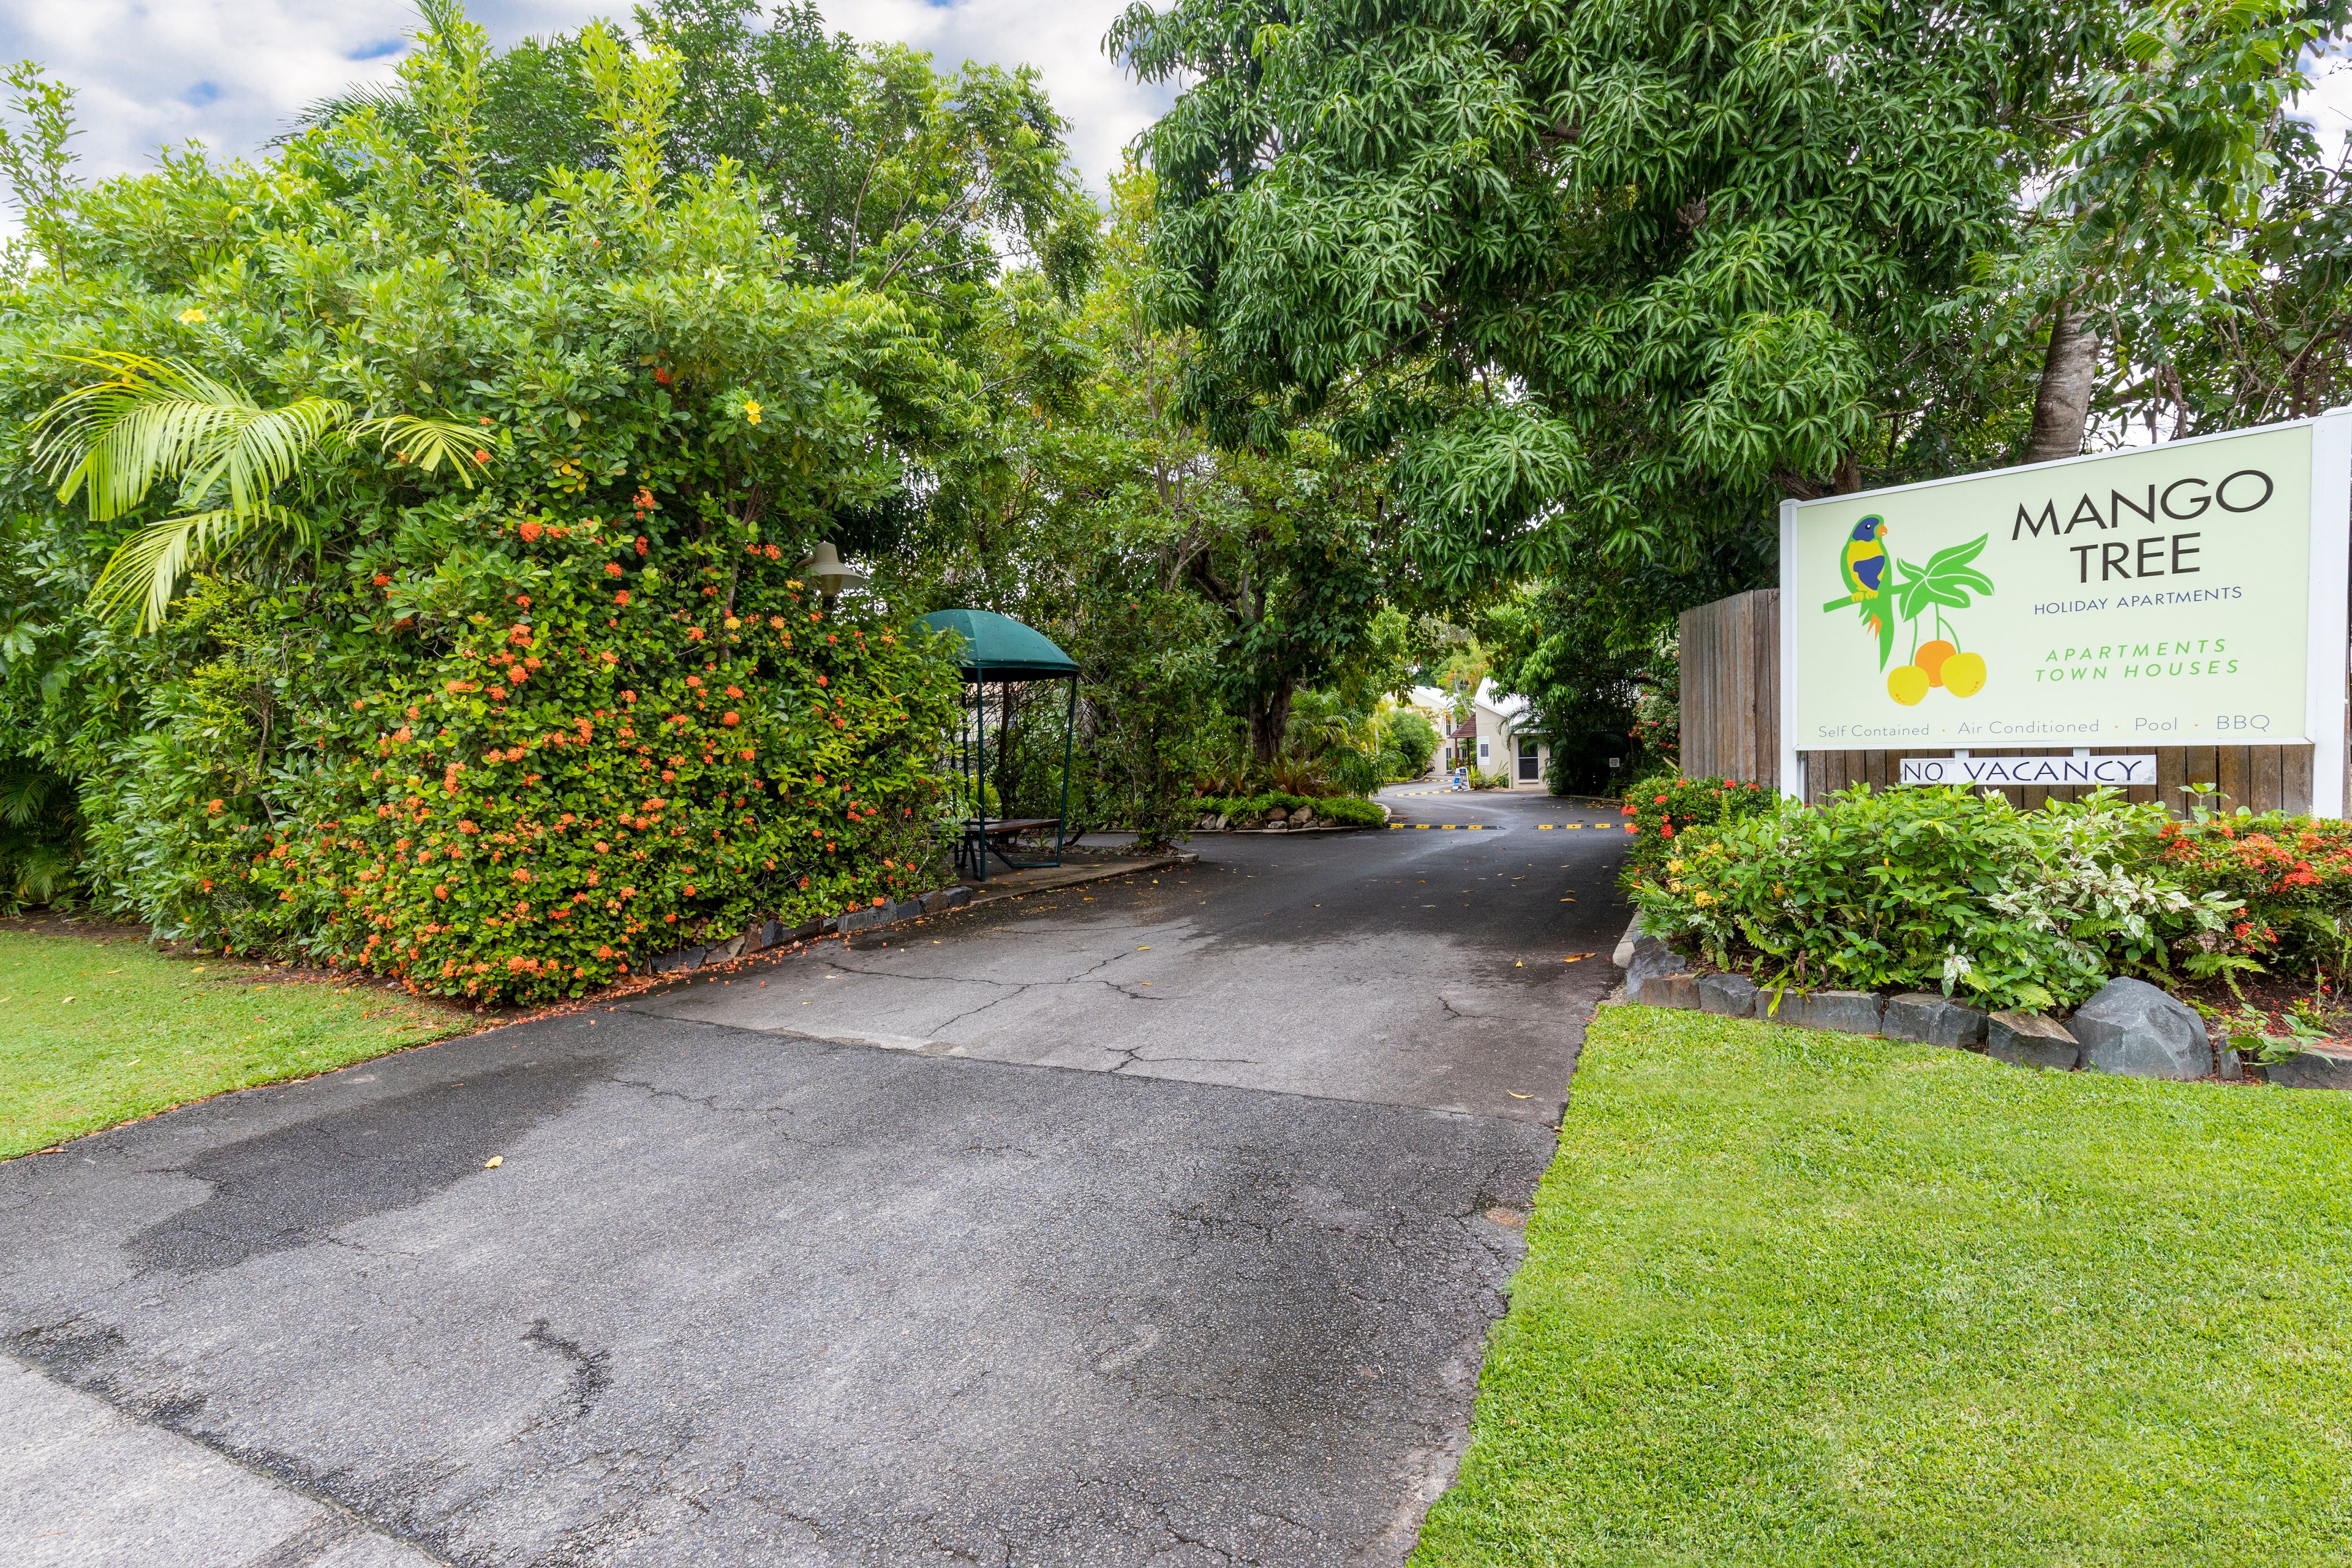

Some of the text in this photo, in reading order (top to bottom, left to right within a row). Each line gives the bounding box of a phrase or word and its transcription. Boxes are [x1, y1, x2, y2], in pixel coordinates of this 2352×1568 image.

[2011, 469, 2274, 541] MANGO
[2070, 532, 2201, 584] TREE
[2034, 586, 2243, 616] HOLIDAY APARTMENTS
[2045, 638, 2227, 662] APARTMENTS
[2035, 659, 2239, 682] TOWN HOUSES
[1819, 714, 2271, 737] Self Contained Air Conditioned Pool BBQ
[1904, 760, 2143, 782] NO VACANCY
